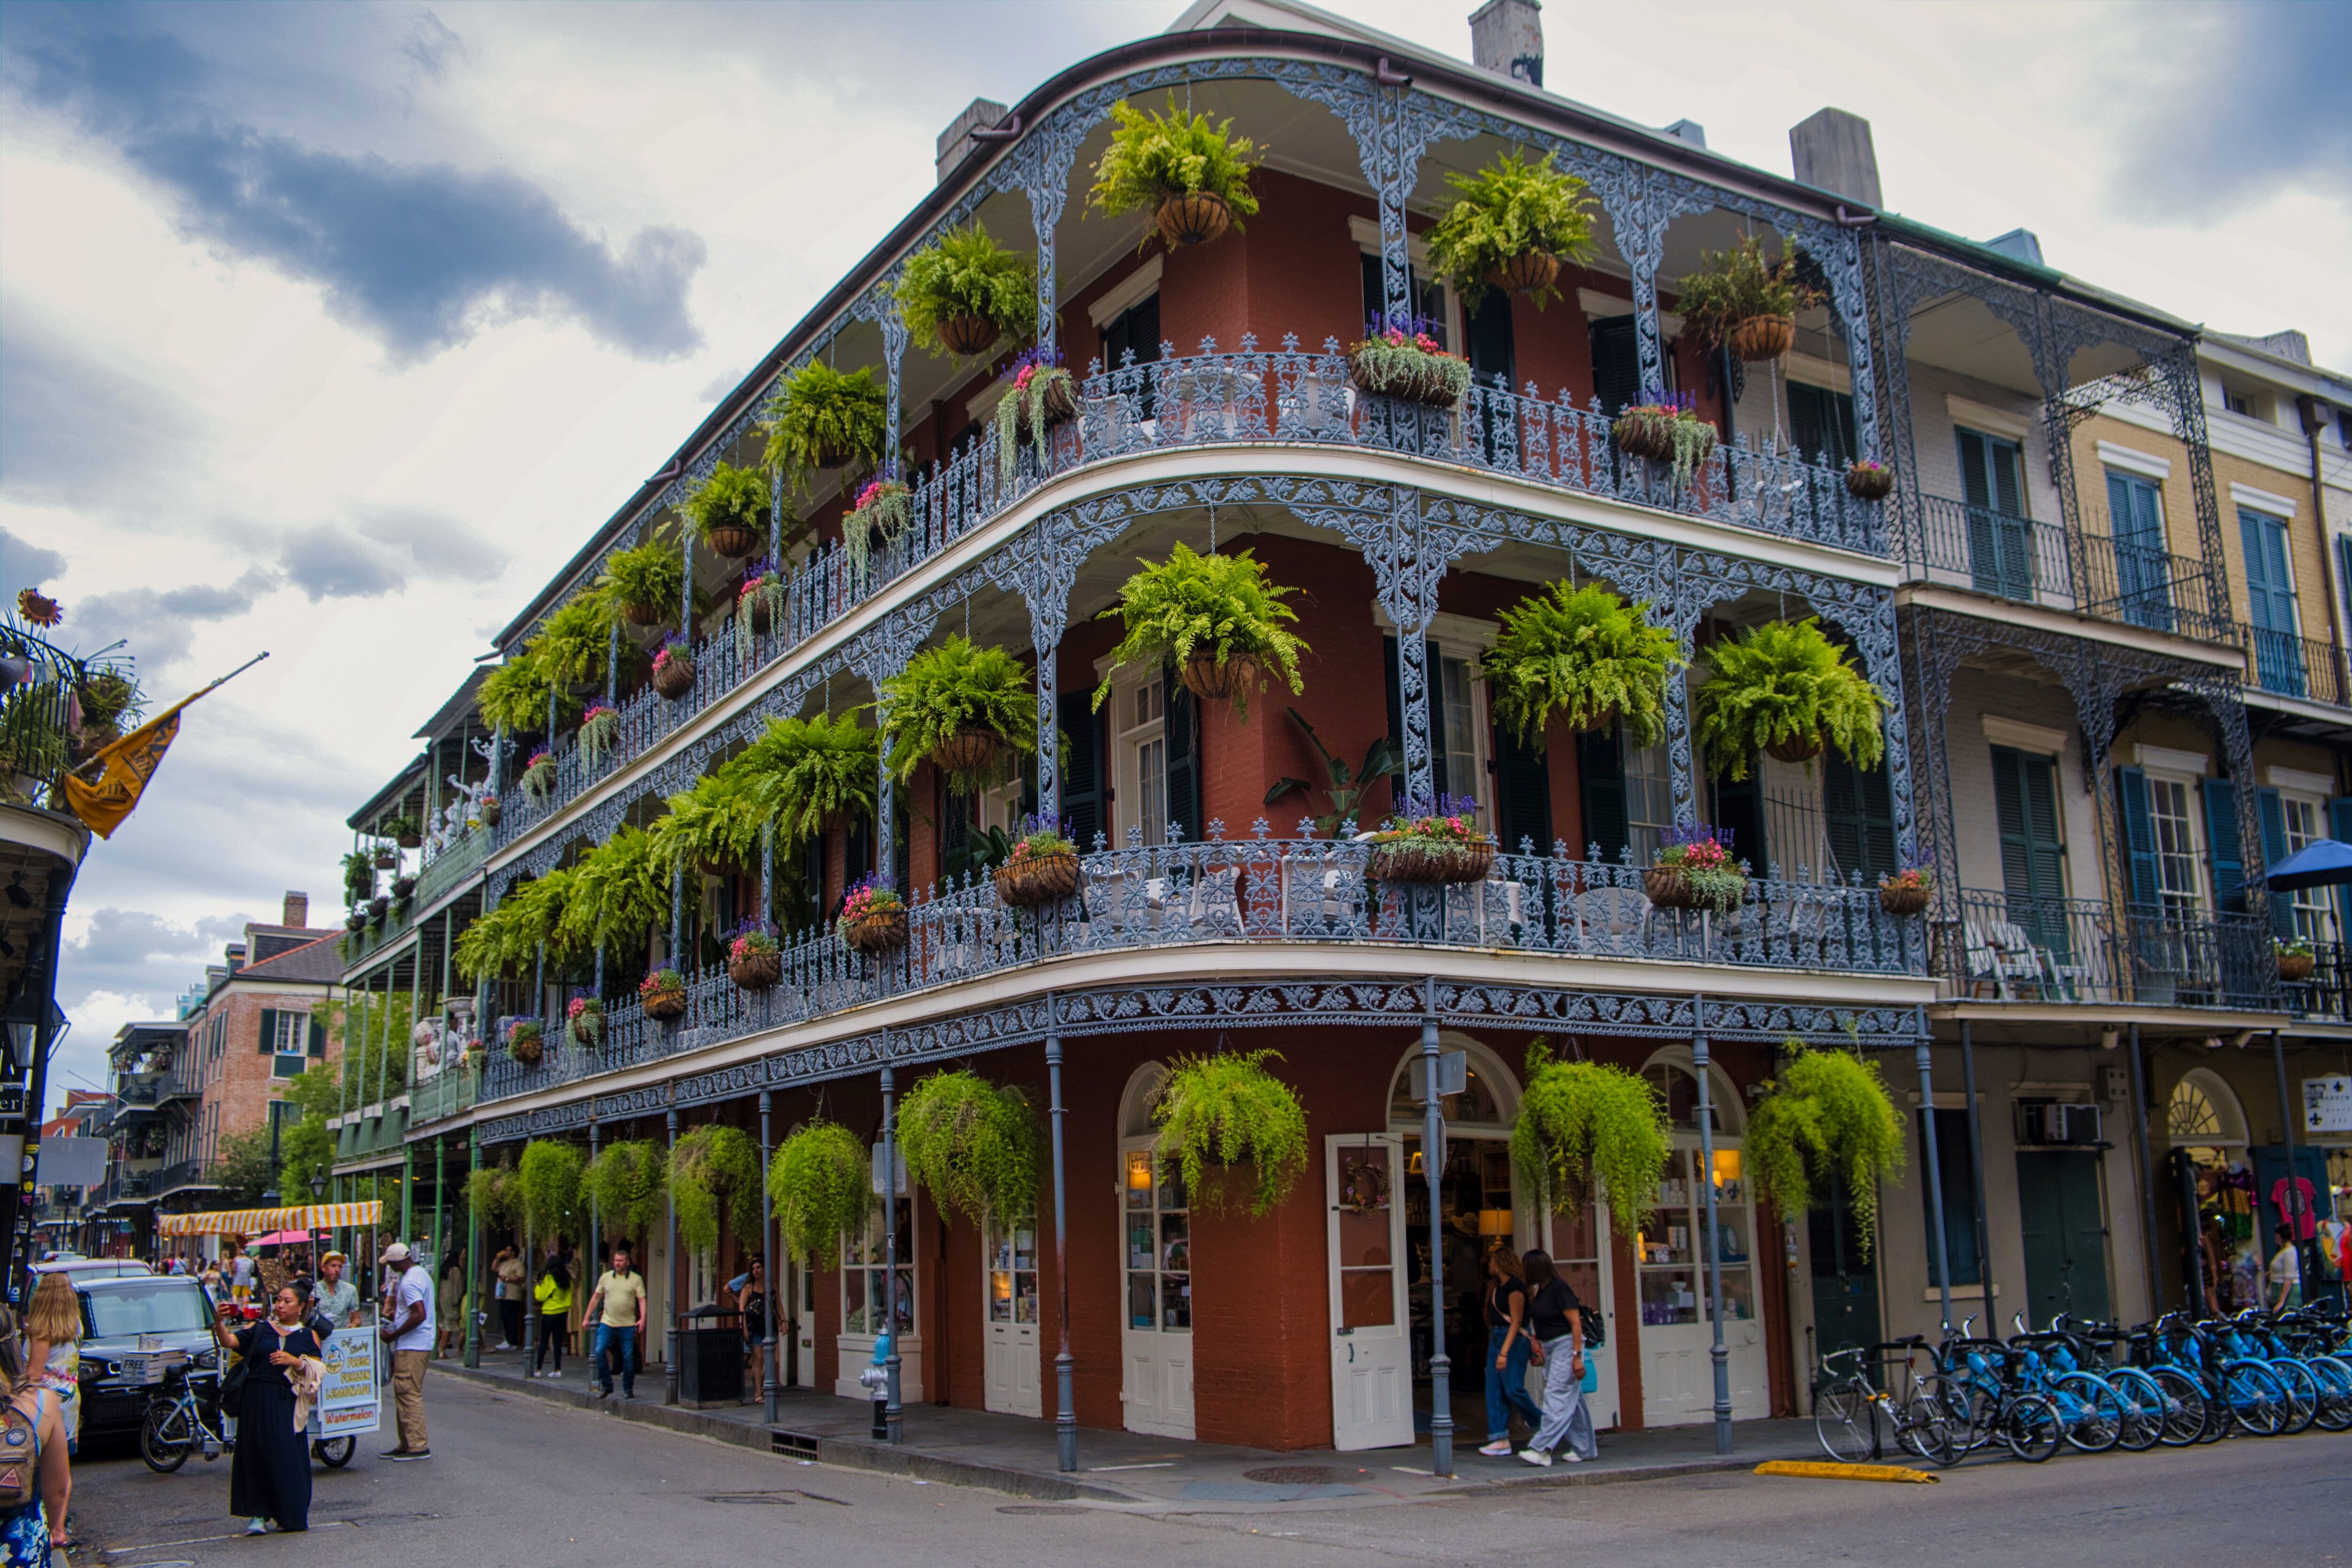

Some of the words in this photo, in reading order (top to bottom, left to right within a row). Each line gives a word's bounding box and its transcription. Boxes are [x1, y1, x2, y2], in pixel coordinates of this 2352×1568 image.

[124, 1360, 144, 1369] FREE
[347, 1356, 370, 1368] FRESH
[341, 1369, 371, 1383] FROZEN
[326, 1384, 371, 1400] LEMONADE
[326, 1409, 373, 1425] Watermelon
